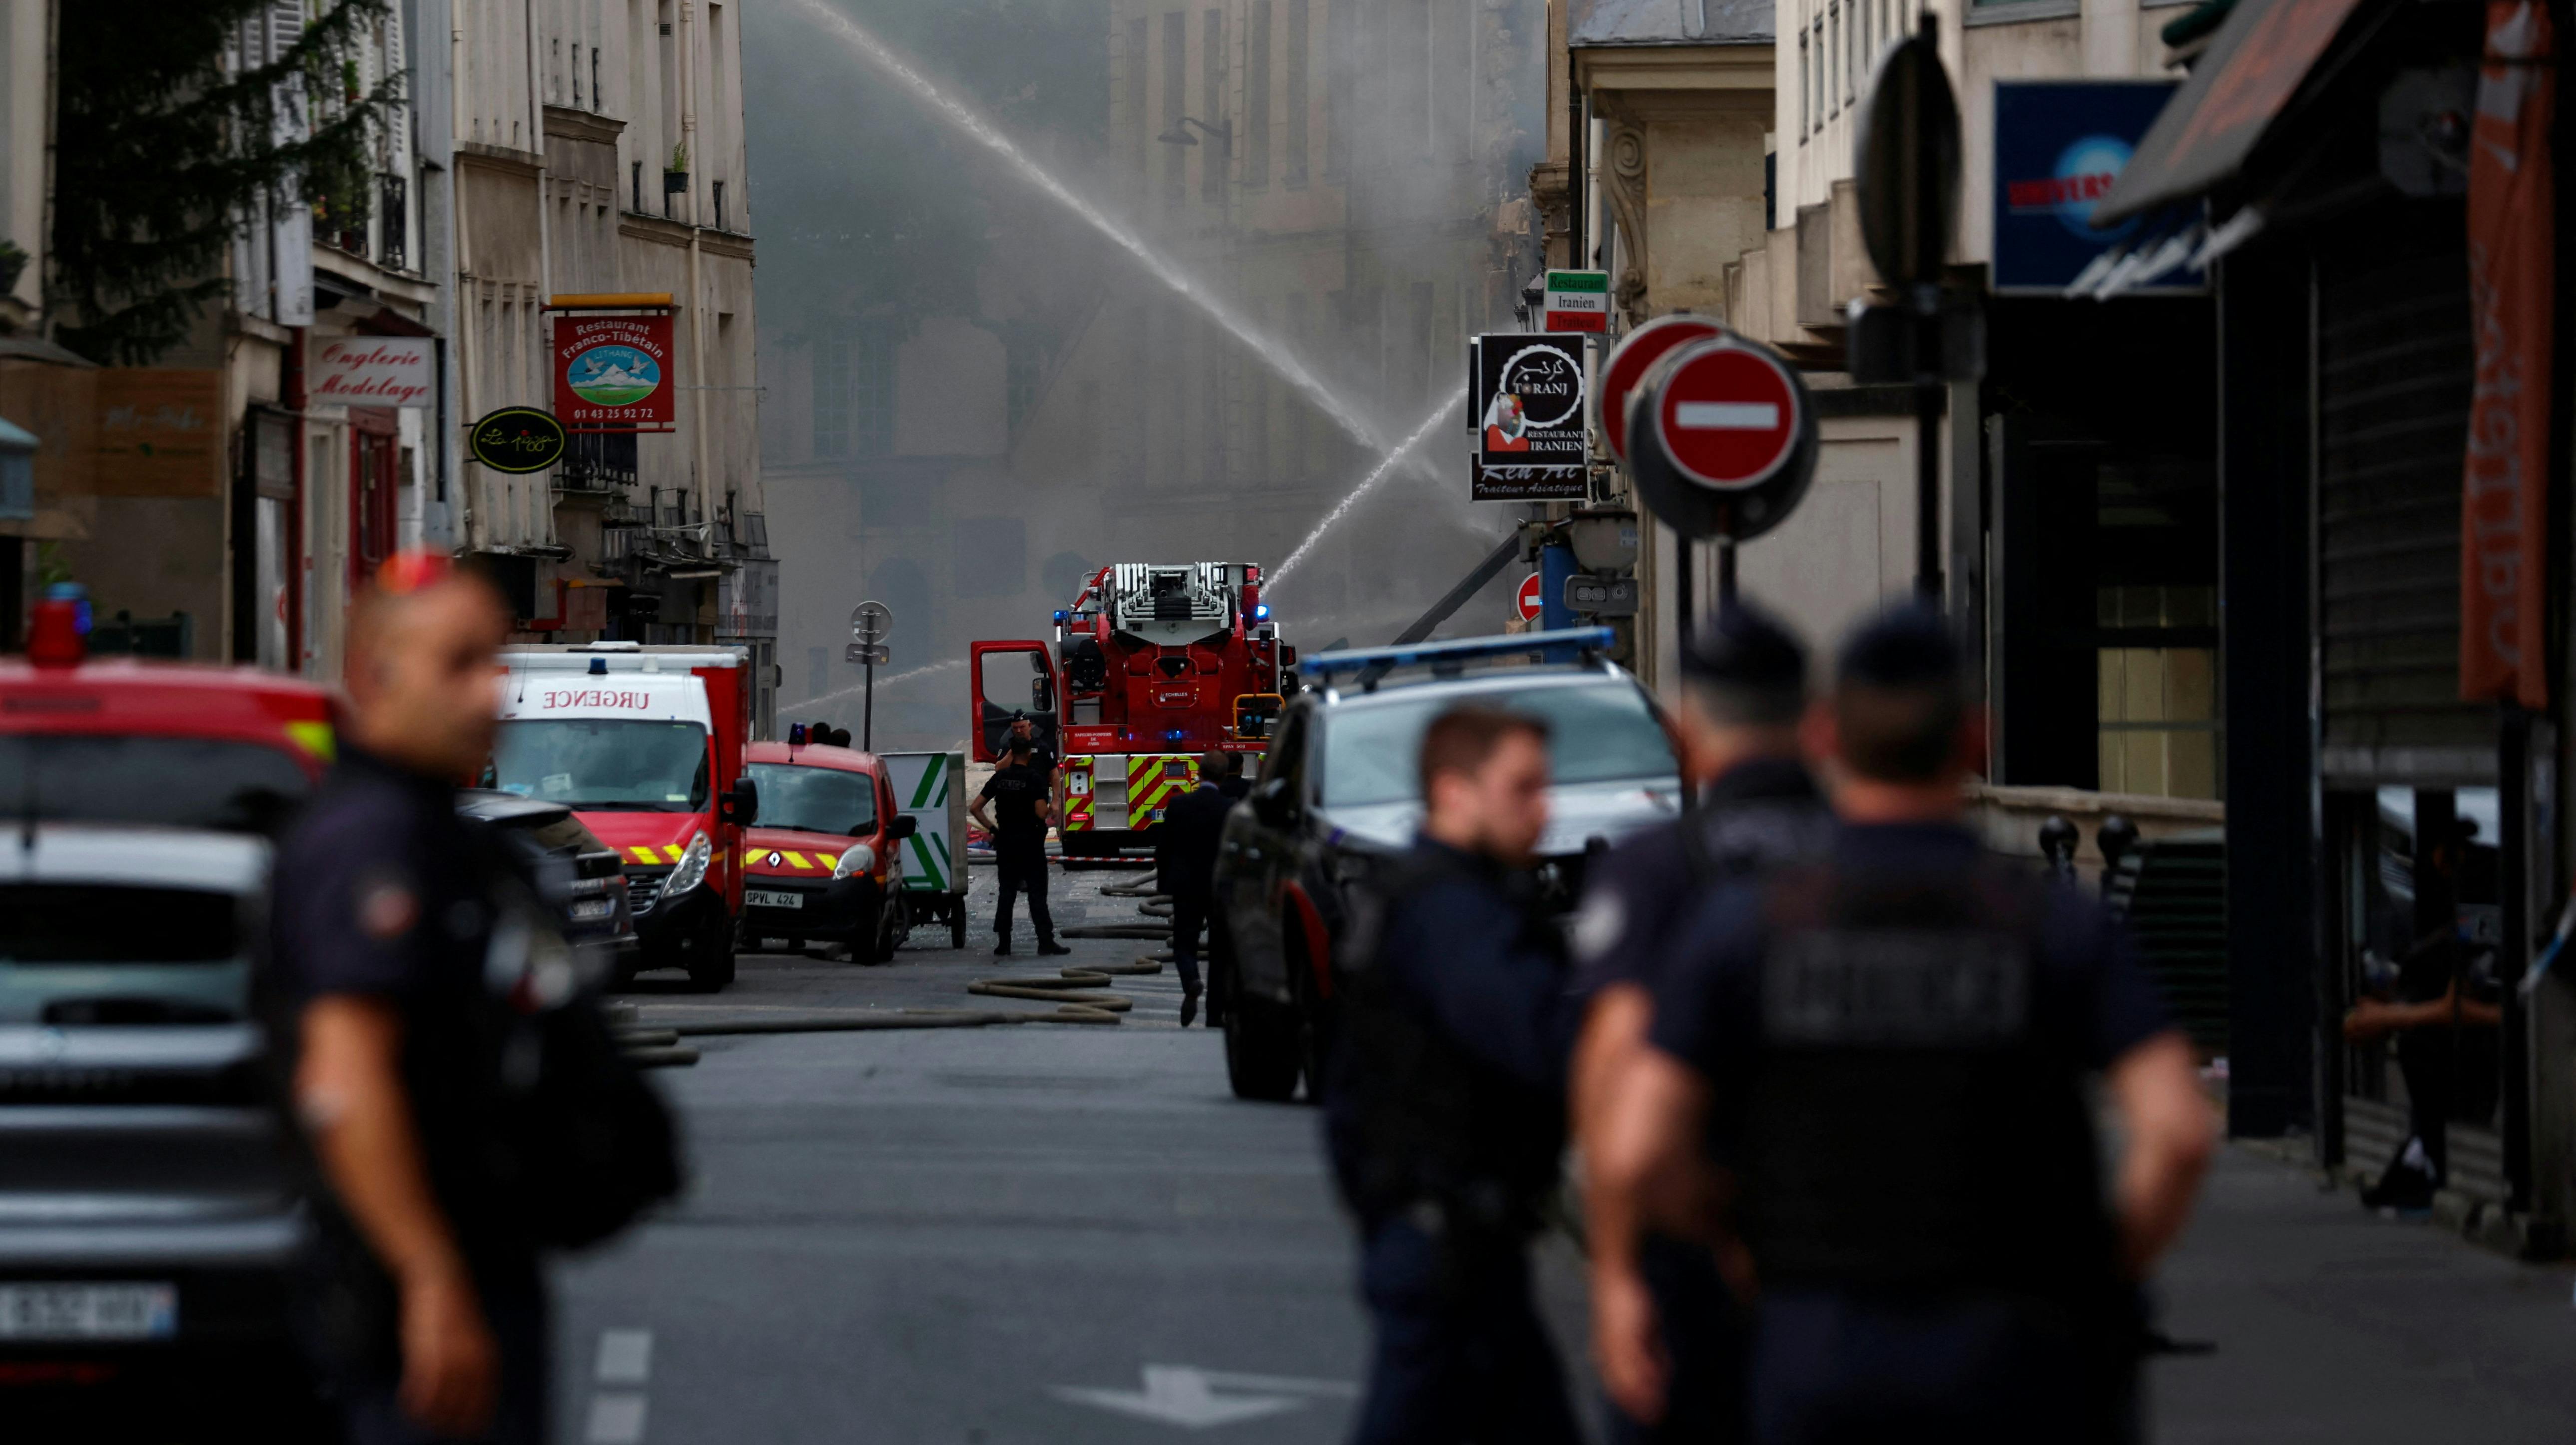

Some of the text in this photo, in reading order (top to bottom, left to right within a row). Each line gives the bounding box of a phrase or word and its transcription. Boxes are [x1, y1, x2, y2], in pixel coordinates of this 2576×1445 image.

[1550, 275, 1604, 289] Restaurant
[1558, 295, 1595, 308] Iranien
[575, 320, 651, 335] Restaurant
[1556, 315, 1597, 328] Traiteur
[562, 331, 664, 359] Franco-Tibétain
[321, 343, 421, 371] Onglerie
[595, 350, 633, 359] LITHANG
[313, 374, 429, 403] Modelage
[575, 408, 653, 418] 01 43 25 92 72
[480, 428, 507, 445] La
[1530, 441, 1583, 450] IRANIEN
[1476, 482, 1583, 495] Traiteur Asiatique
[747, 892, 770, 904] SPVL
